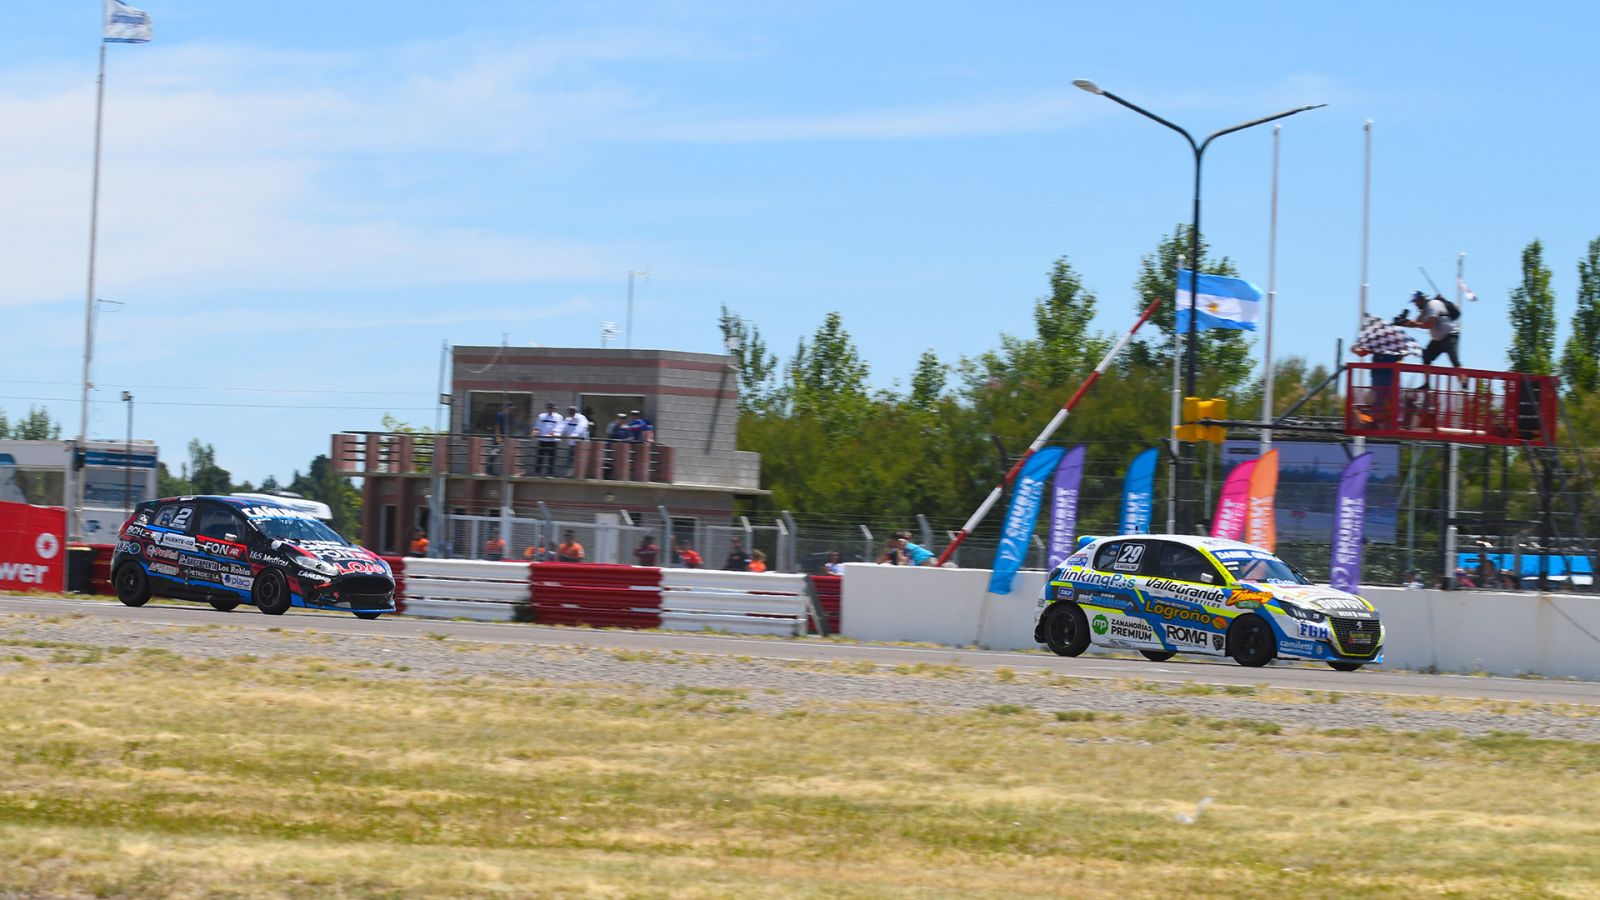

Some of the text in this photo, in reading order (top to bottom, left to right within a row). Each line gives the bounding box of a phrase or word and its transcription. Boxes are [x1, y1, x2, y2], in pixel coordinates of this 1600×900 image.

[174, 507, 193, 524] 2
[205, 542, 230, 555] FON
[1118, 546, 1143, 563] 29
[0, 562, 49, 585] wer
[218, 564, 229, 572] Los
[230, 566, 251, 576] Robles
[1145, 600, 1210, 624] Logroño
[1111, 619, 1152, 632] ZANAHORIAS
[1111, 626, 1152, 641] PREMIUM
[1300, 623, 1328, 639] FGH
[1166, 625, 1208, 646] ROMA
[1280, 640, 1313, 651] camiletti
